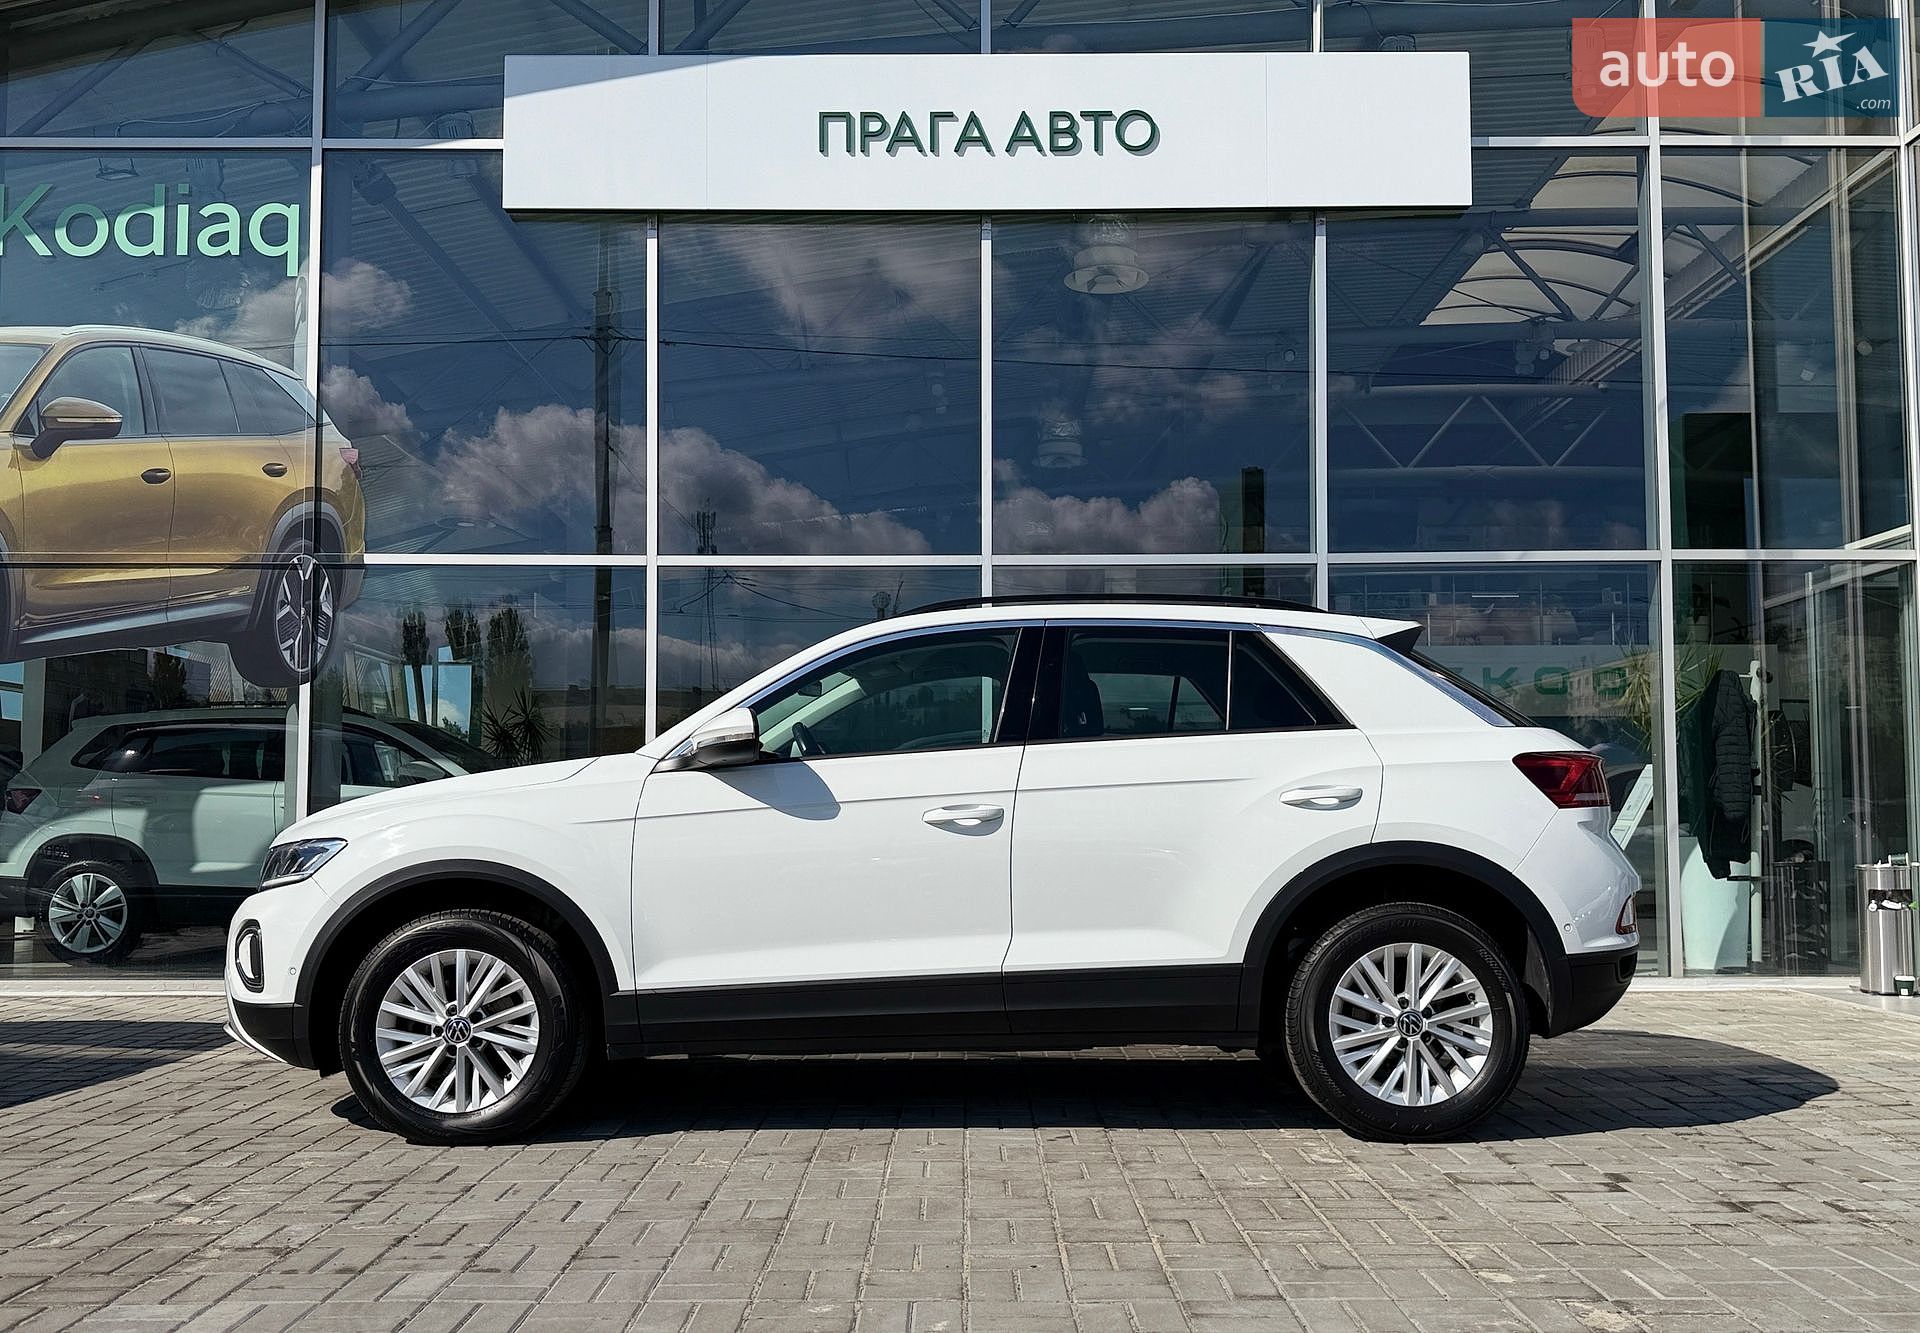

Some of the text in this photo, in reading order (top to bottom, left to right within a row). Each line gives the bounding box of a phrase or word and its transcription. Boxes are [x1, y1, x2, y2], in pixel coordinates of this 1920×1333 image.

[819, 109, 1160, 156] ПРАГА АВТО
[0, 183, 300, 277] Kodiaq
